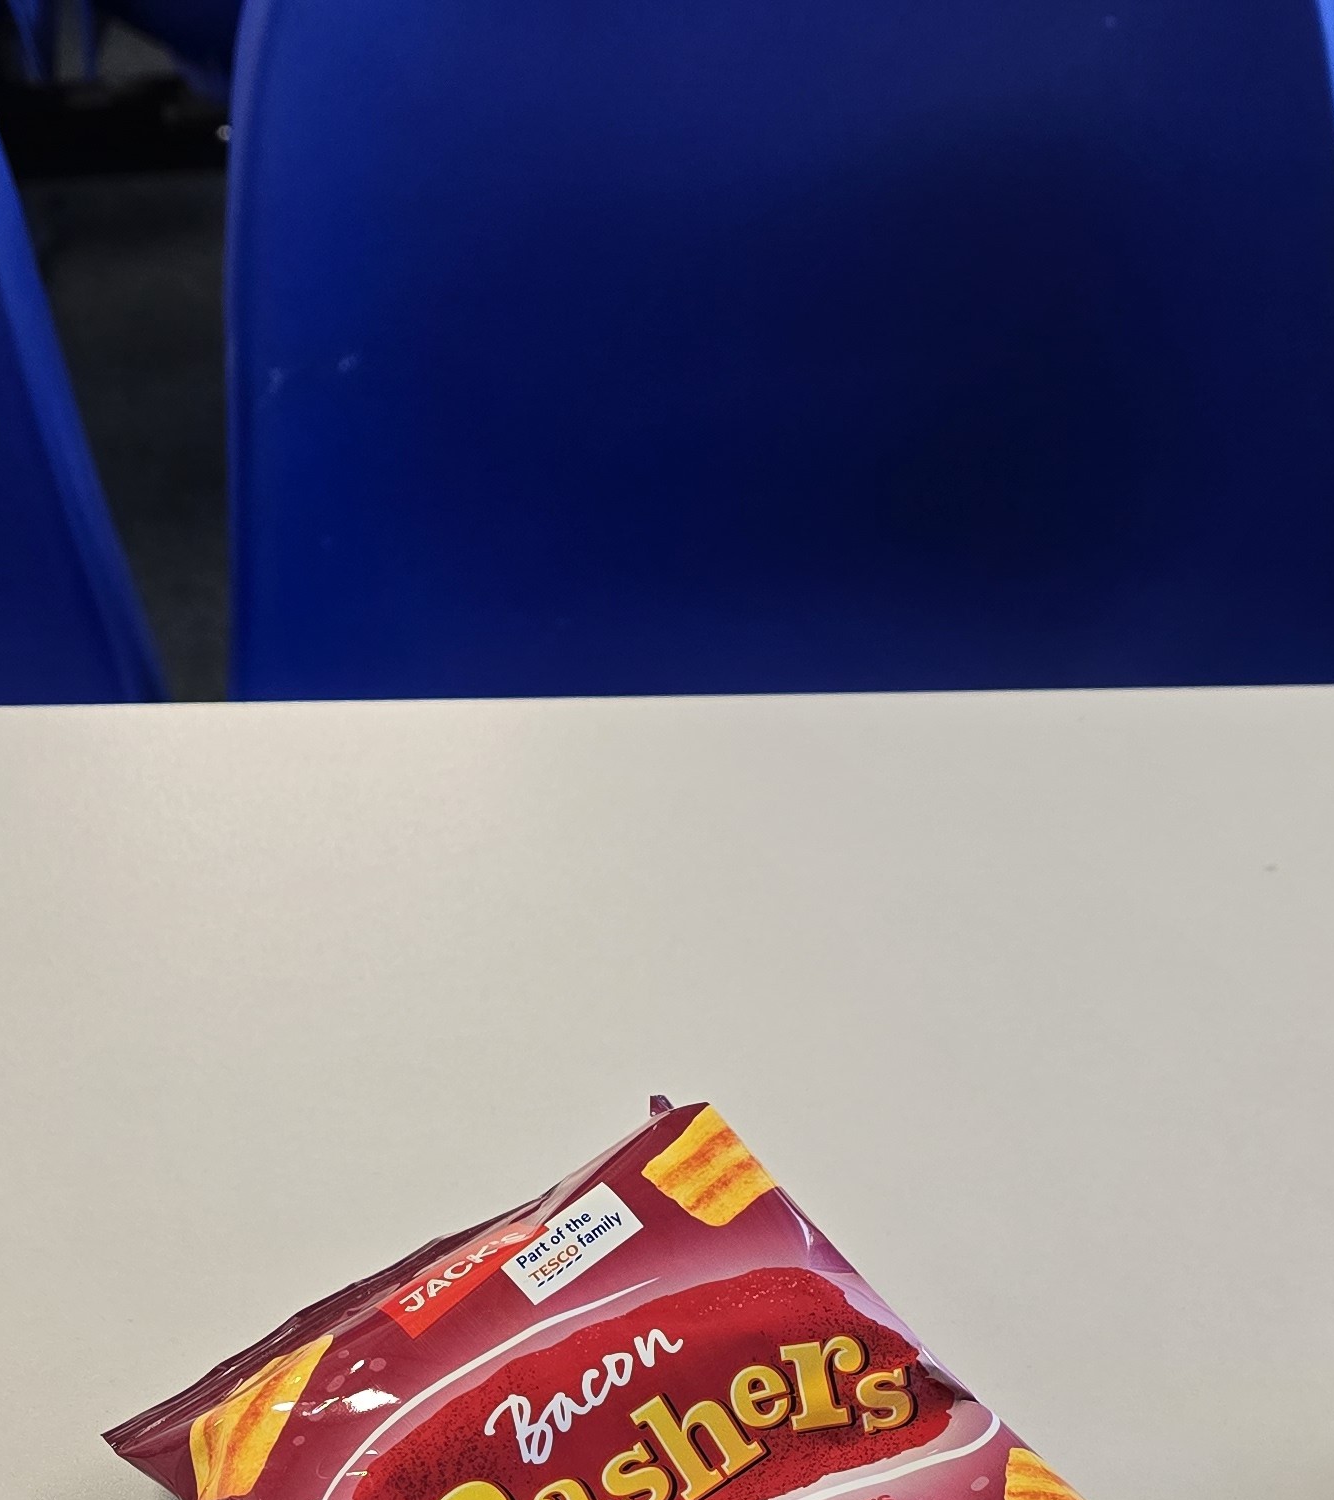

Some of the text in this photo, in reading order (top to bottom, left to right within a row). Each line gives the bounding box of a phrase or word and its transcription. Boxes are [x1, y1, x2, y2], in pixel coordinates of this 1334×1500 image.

[399, 1232, 528, 1312] JACK'S
[516, 1211, 592, 1270] Part of the
[528, 1211, 623, 1282] TESCO family
[485, 1328, 683, 1464] Bacon
